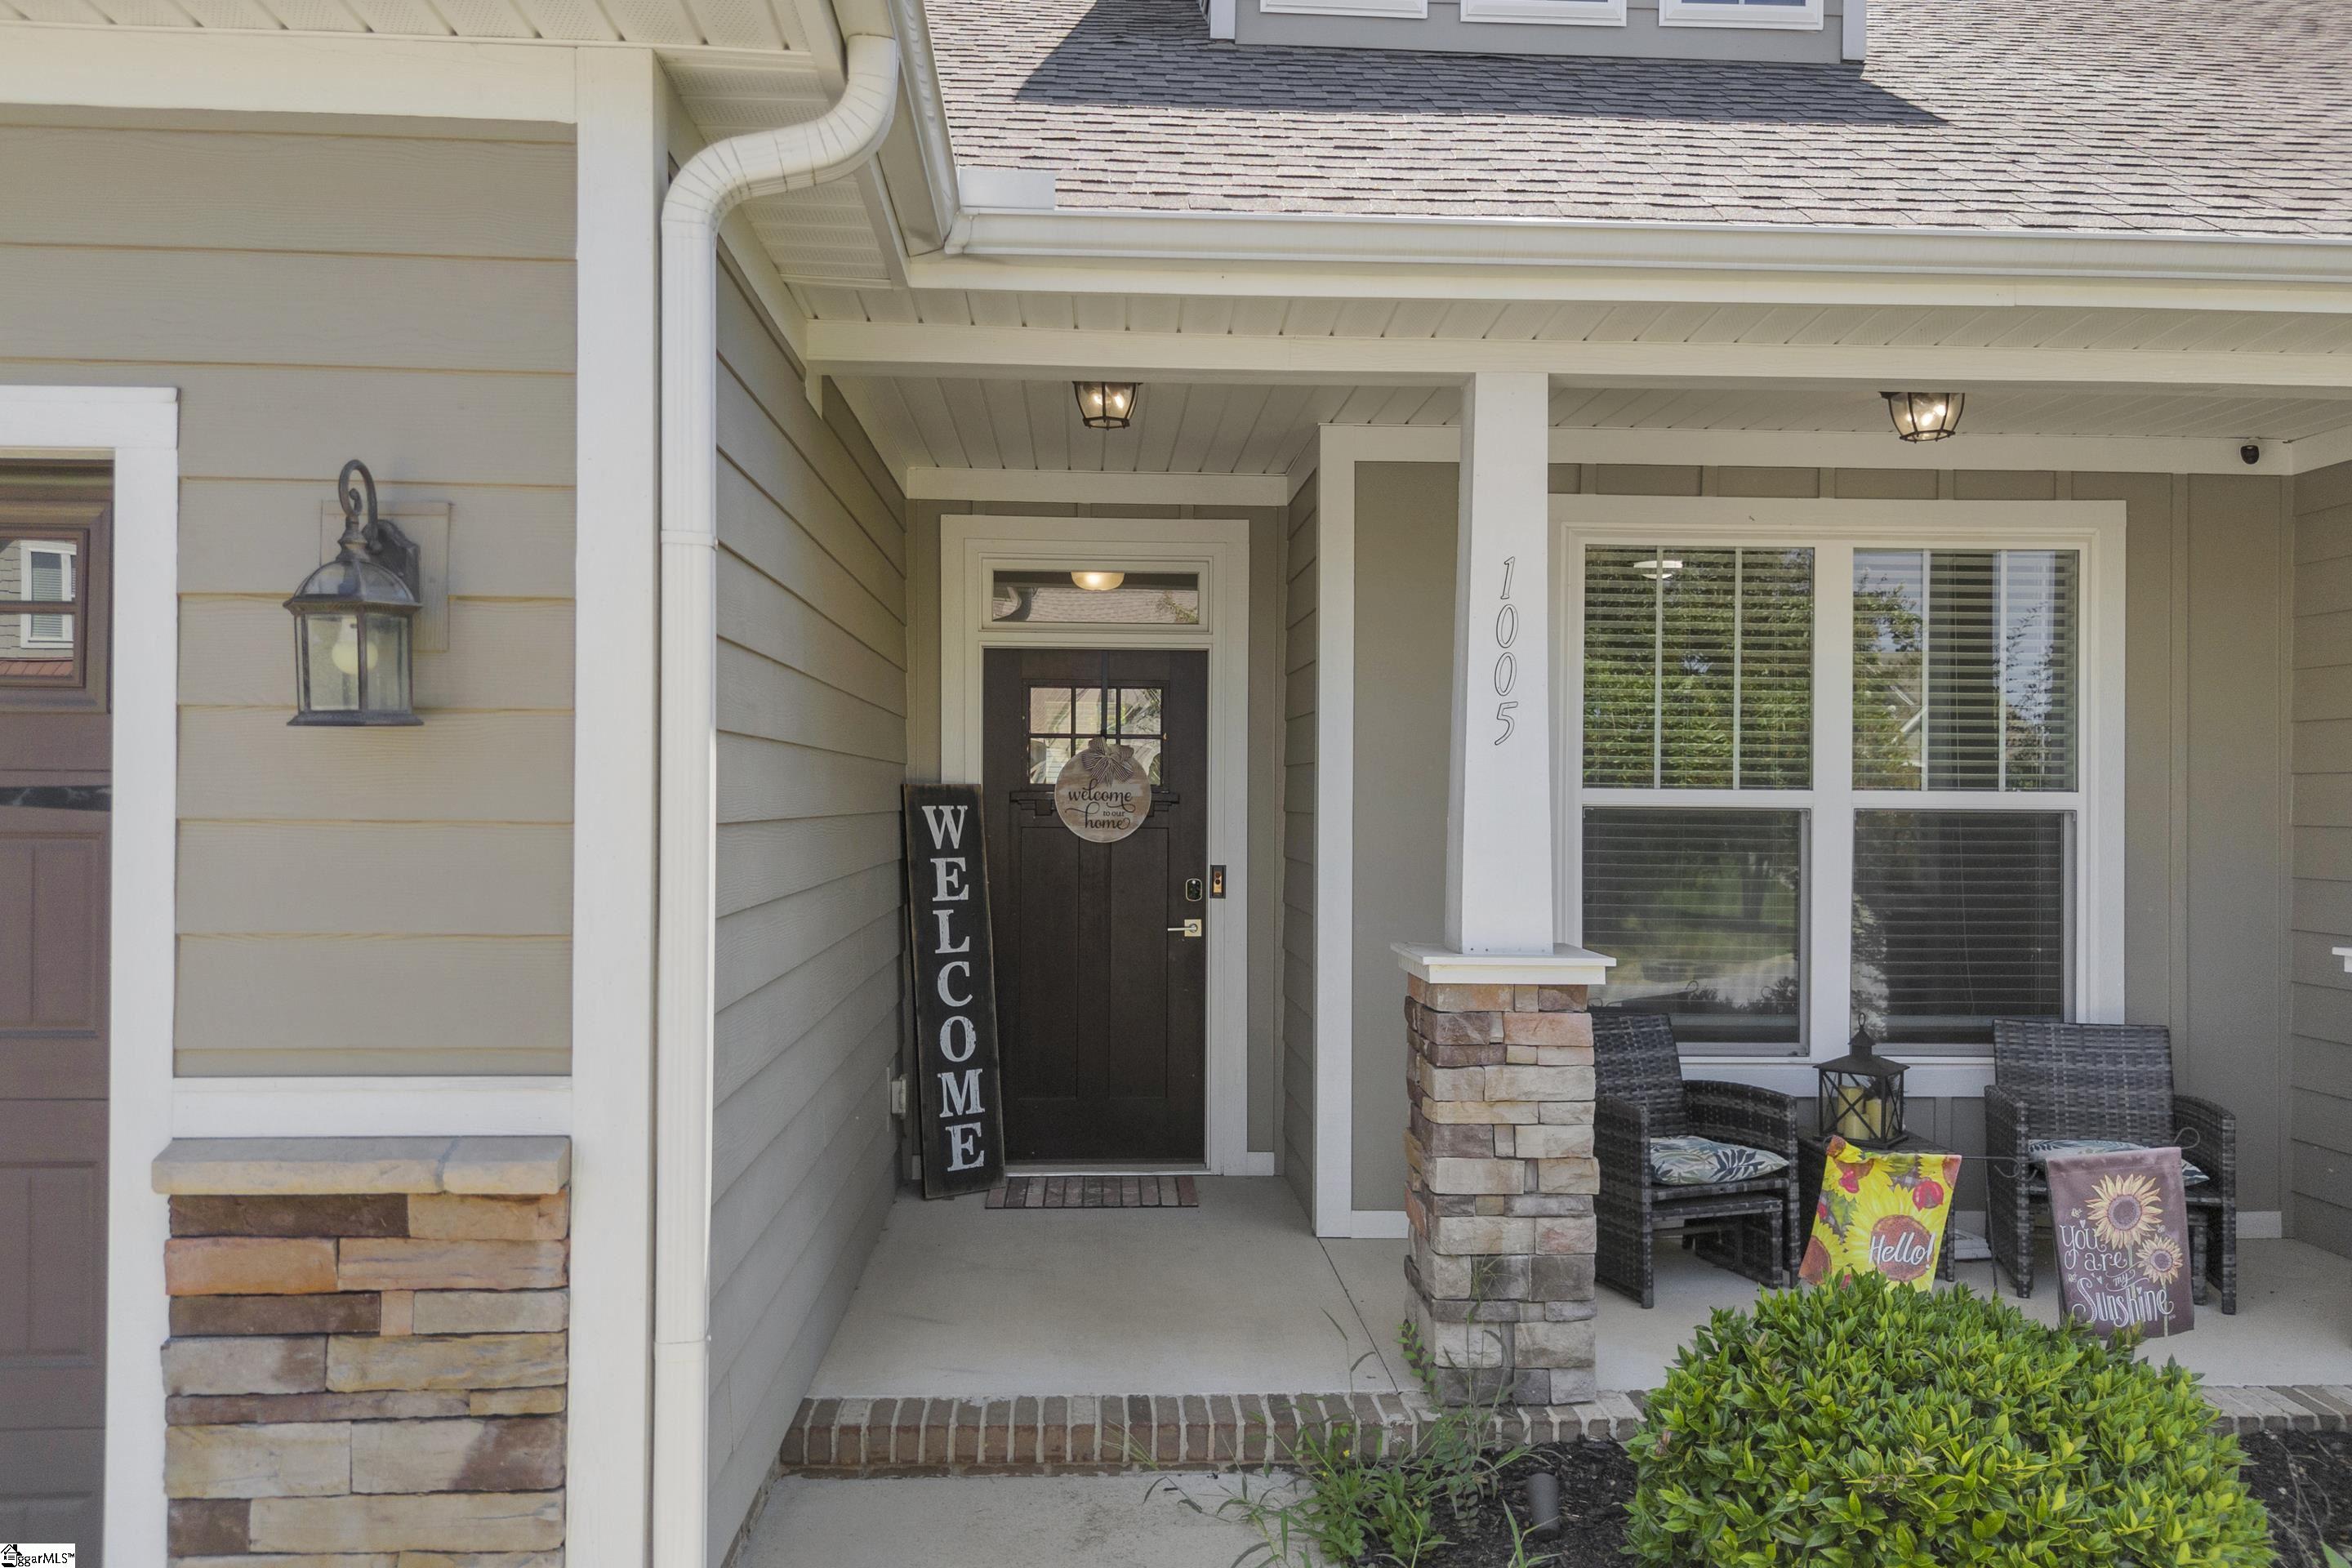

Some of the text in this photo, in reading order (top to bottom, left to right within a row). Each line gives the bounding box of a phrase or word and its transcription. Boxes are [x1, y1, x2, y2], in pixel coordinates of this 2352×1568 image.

[1494, 556, 1519, 746] 1005
[1068, 778, 1136, 813] welcome
[1065, 802, 1130, 830] home
[921, 804, 986, 1172] WELCOME
[1868, 1232, 1936, 1269] Hello!
[2084, 1251, 2127, 1272] are
[2113, 1273, 2129, 1288] my
[2072, 1277, 2174, 1328] Sunshine
